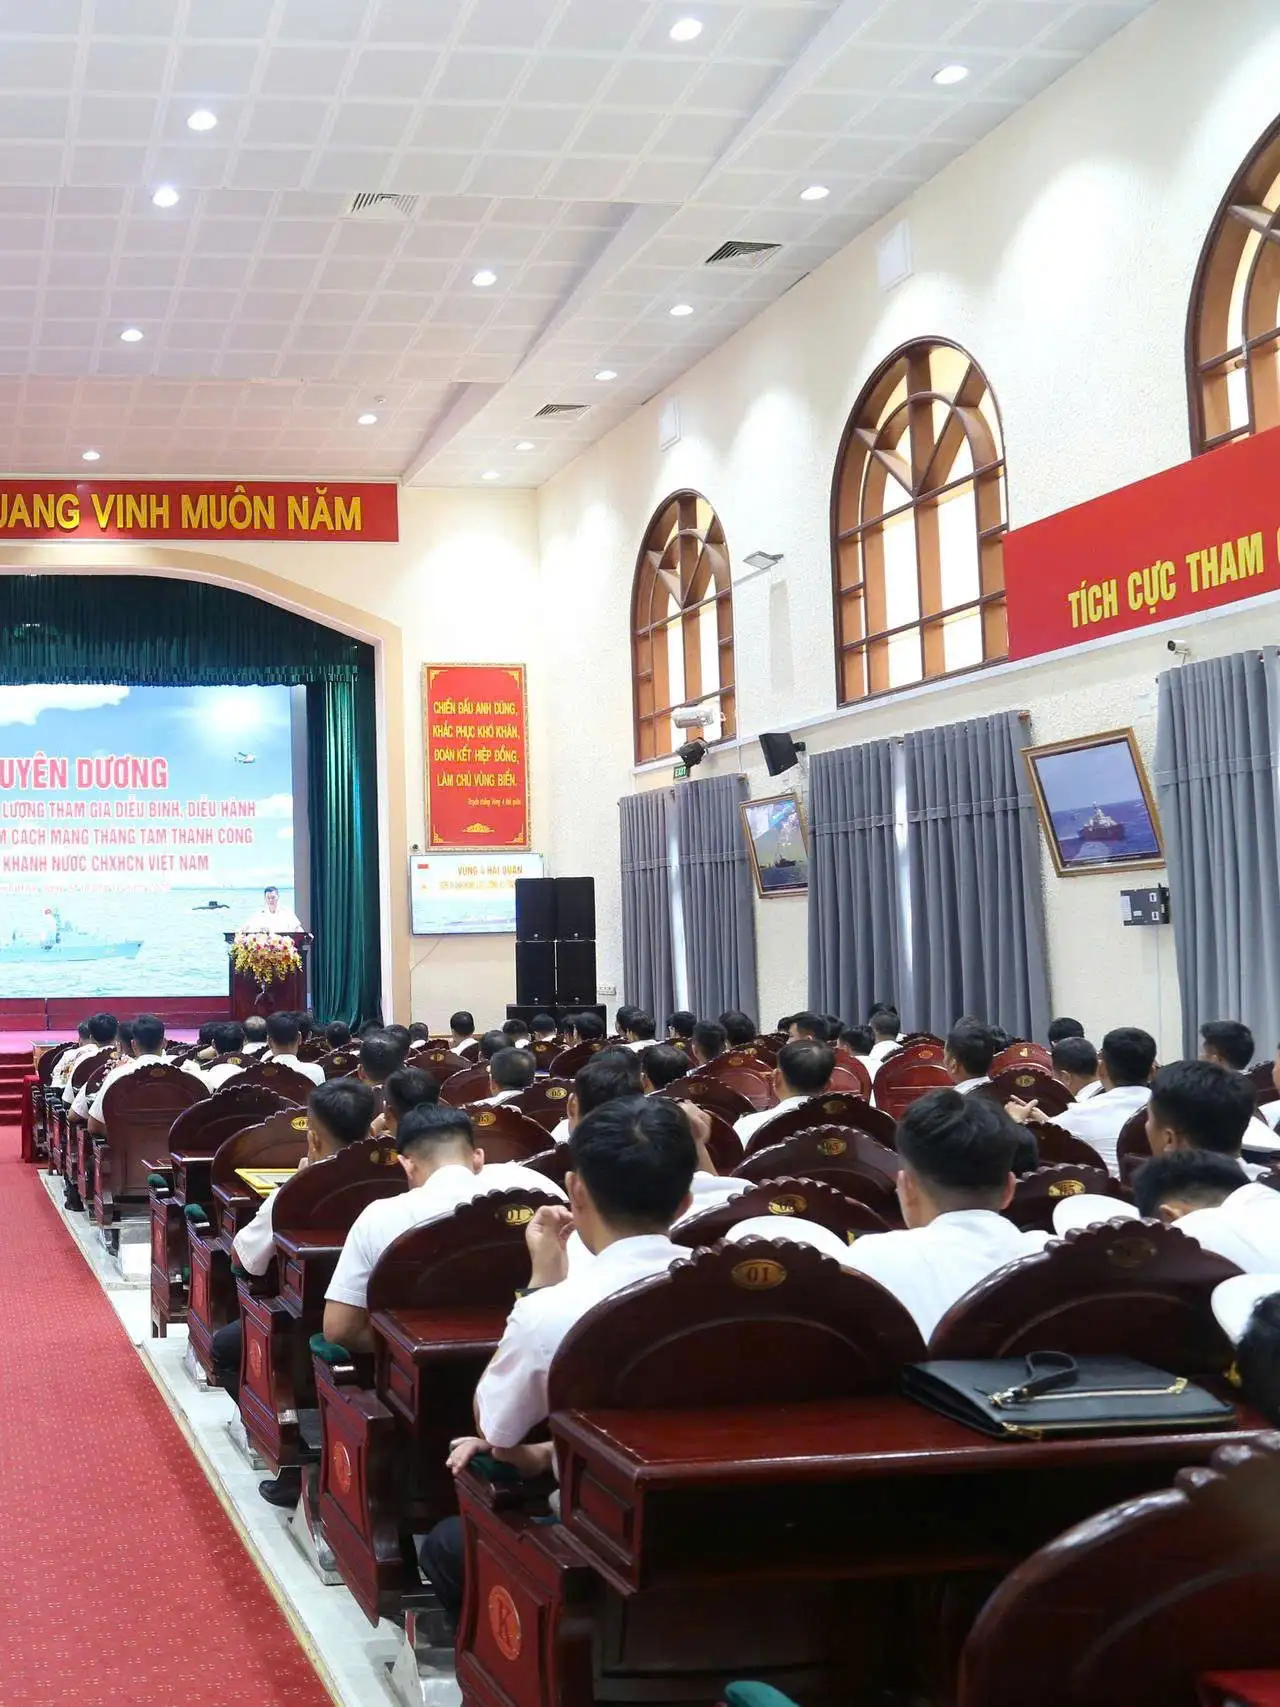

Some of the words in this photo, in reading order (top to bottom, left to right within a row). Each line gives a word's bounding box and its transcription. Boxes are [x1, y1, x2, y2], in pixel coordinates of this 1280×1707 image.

[91, 494, 169, 529] VINH
[181, 485, 274, 530] MUÔN
[287, 486, 362, 531] NĂM
[1068, 580, 1119, 628] TÍCH
[1127, 560, 1176, 614] CỰC
[1185, 531, 1264, 593] THAM
[476, 702, 492, 714] ANH
[77, 755, 167, 788] DƯƠNG
[49, 802, 86, 818] THAM
[90, 802, 112, 818] GIA
[91, 854, 144, 872] CHXHCN
[179, 854, 209, 871] NAM
[747, 1269, 770, 1283] 01
